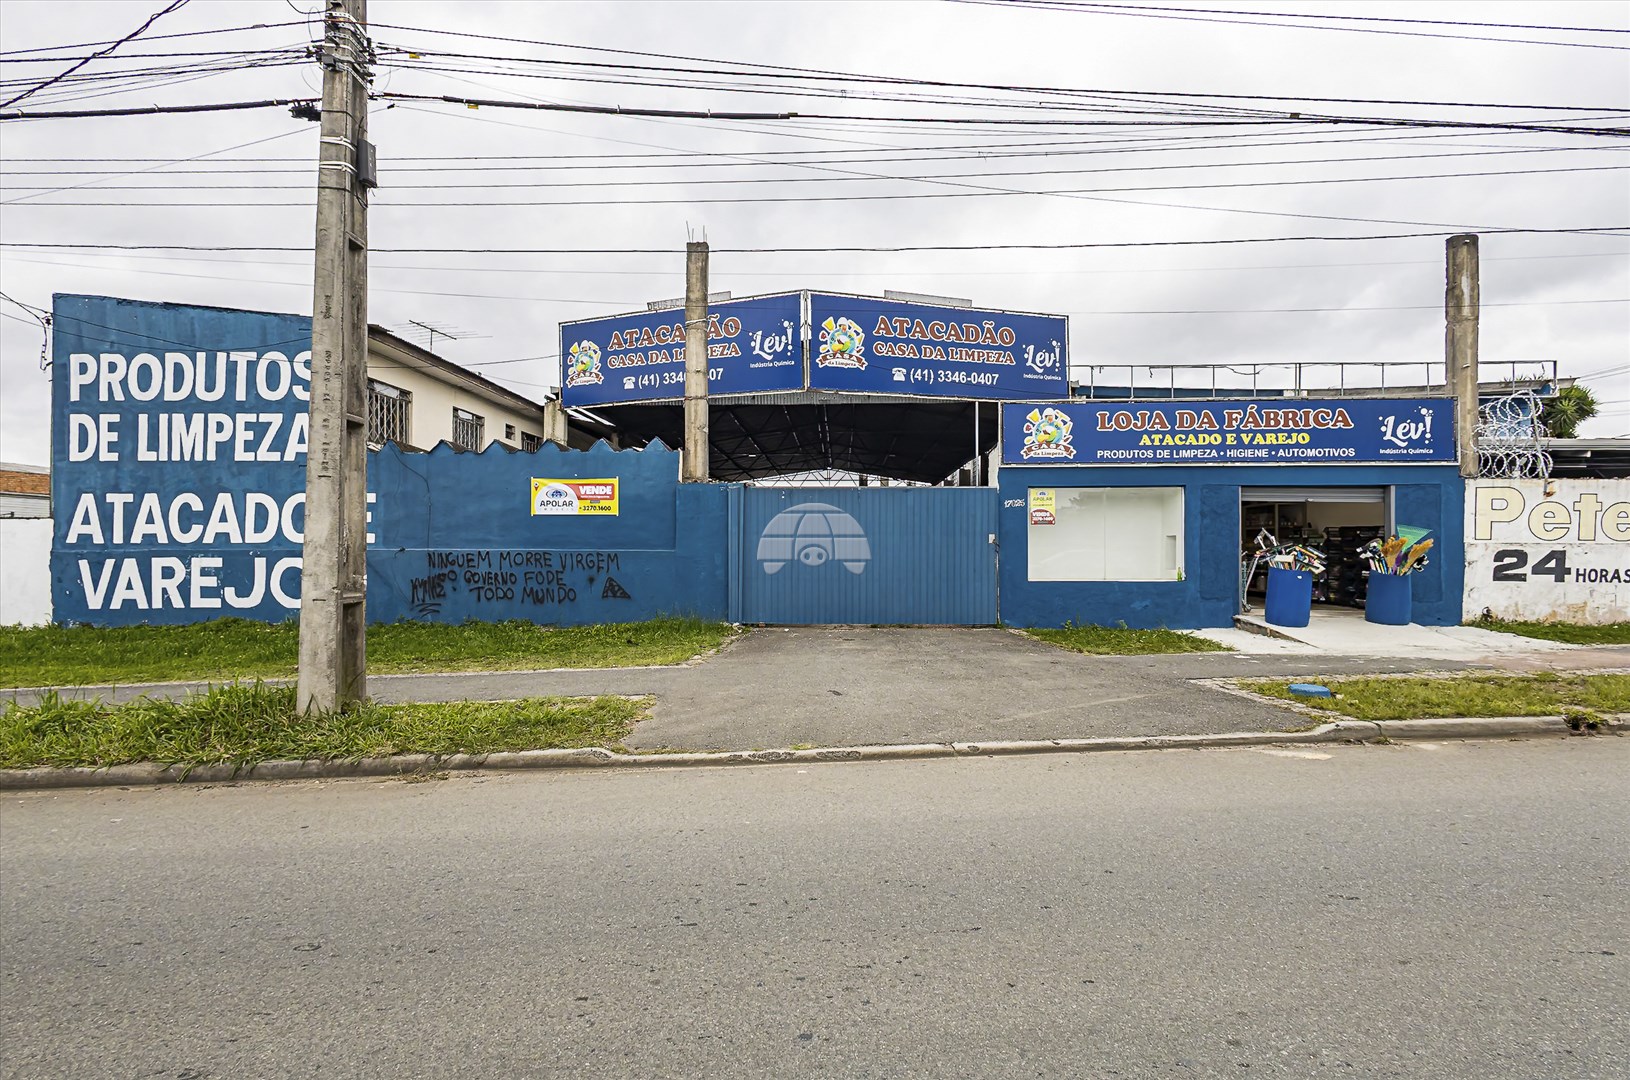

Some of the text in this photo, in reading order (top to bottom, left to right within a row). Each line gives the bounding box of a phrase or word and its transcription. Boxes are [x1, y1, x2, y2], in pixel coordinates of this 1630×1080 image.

[608, 313, 742, 351] ATACAÃO
[752, 327, 793, 361] Lév!
[873, 315, 1016, 347] ATACADÃO
[608, 352, 647, 368] CASA
[648, 350, 671, 365] DA
[873, 342, 1016, 365] CASA DA LIMPEZA
[1026, 344, 1060, 374] Lév!
[69, 350, 313, 402] PRODUTOS
[638, 368, 724, 389] (41) 33407
[910, 367, 999, 386] (41) 3346-0407
[1096, 404, 1354, 431] LOJA DA FÁBRICA
[1382, 415, 1433, 447] Lév!
[69, 413, 310, 462] DE LIMPEZA
[1139, 432, 1311, 446] ATACADO E VAREJO
[1097, 447, 1355, 459] PRODUTOS DE LIMPEZA HIGIENE AUTOMOTIVOS
[579, 485, 613, 495] VENDE
[540, 500, 574, 508] APOLAR
[1475, 486, 1630, 542] Pete
[66, 493, 306, 544] ATACADO
[427, 550, 620, 572] NINGUEM MORRE VIRGEM
[1493, 549, 1571, 582] 24
[78, 557, 304, 609] VAREJO
[464, 569, 517, 586] GOVERNO
[524, 570, 566, 588] FODE
[469, 586, 577, 604] TODO MUNDO
